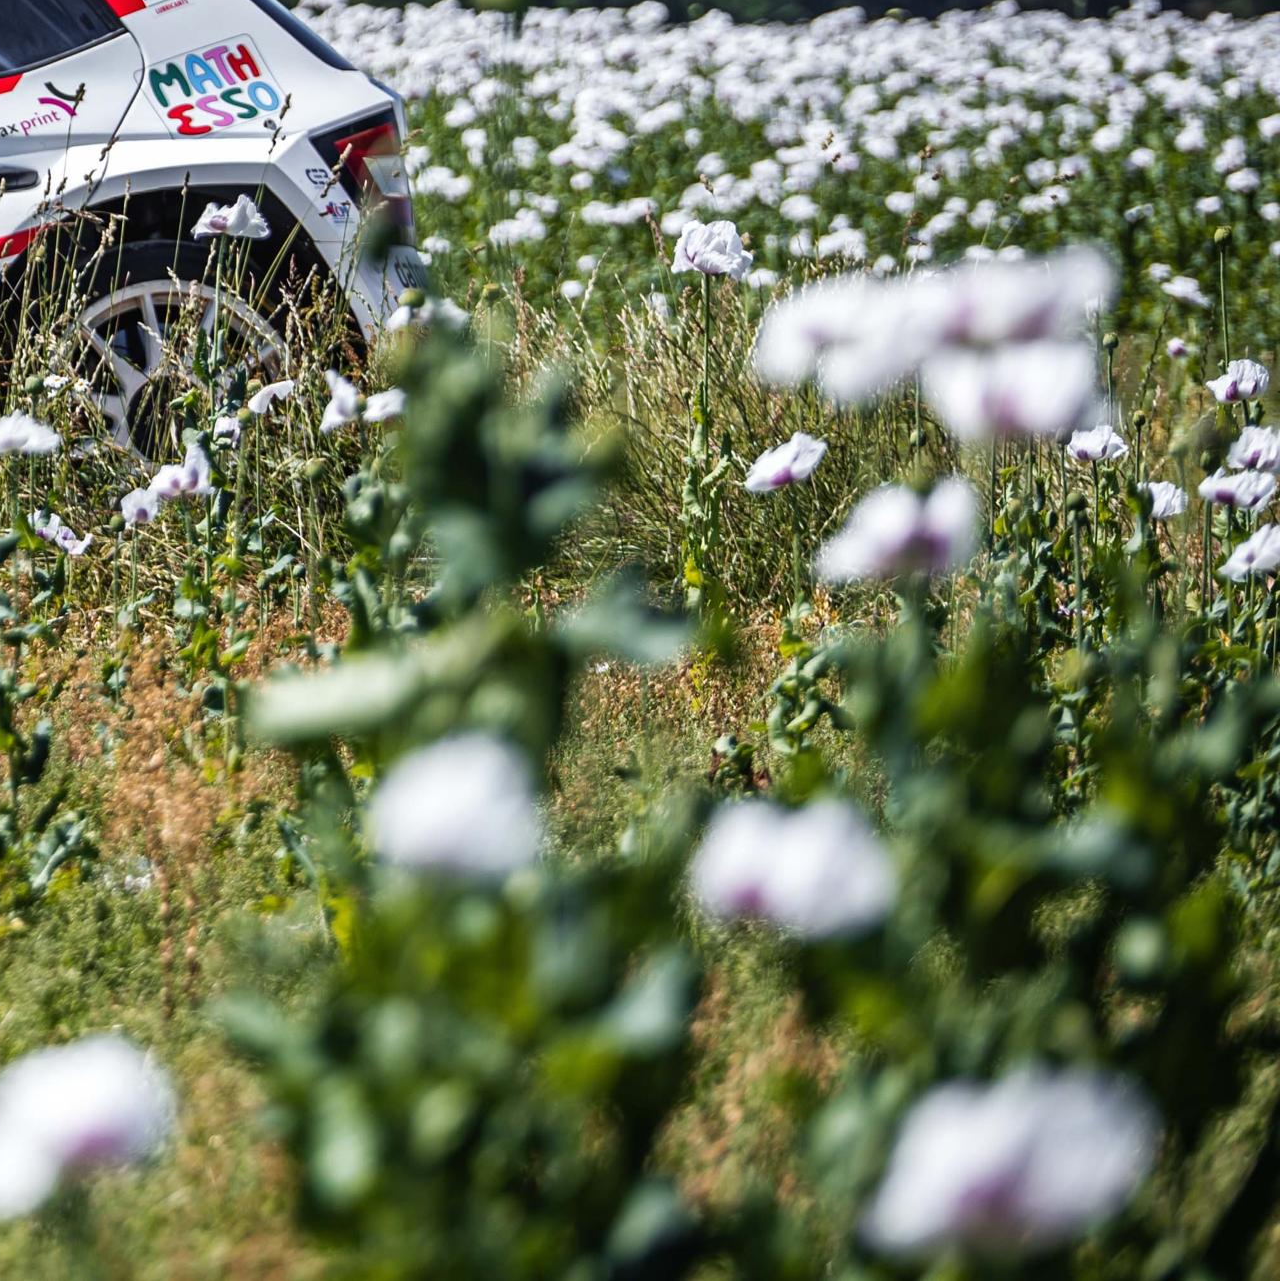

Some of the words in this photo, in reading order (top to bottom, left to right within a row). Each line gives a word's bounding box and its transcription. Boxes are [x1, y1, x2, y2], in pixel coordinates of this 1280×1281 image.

[149, 44, 260, 107] MATH
[20, 110, 61, 137] print
[167, 81, 279, 135] ESSO
